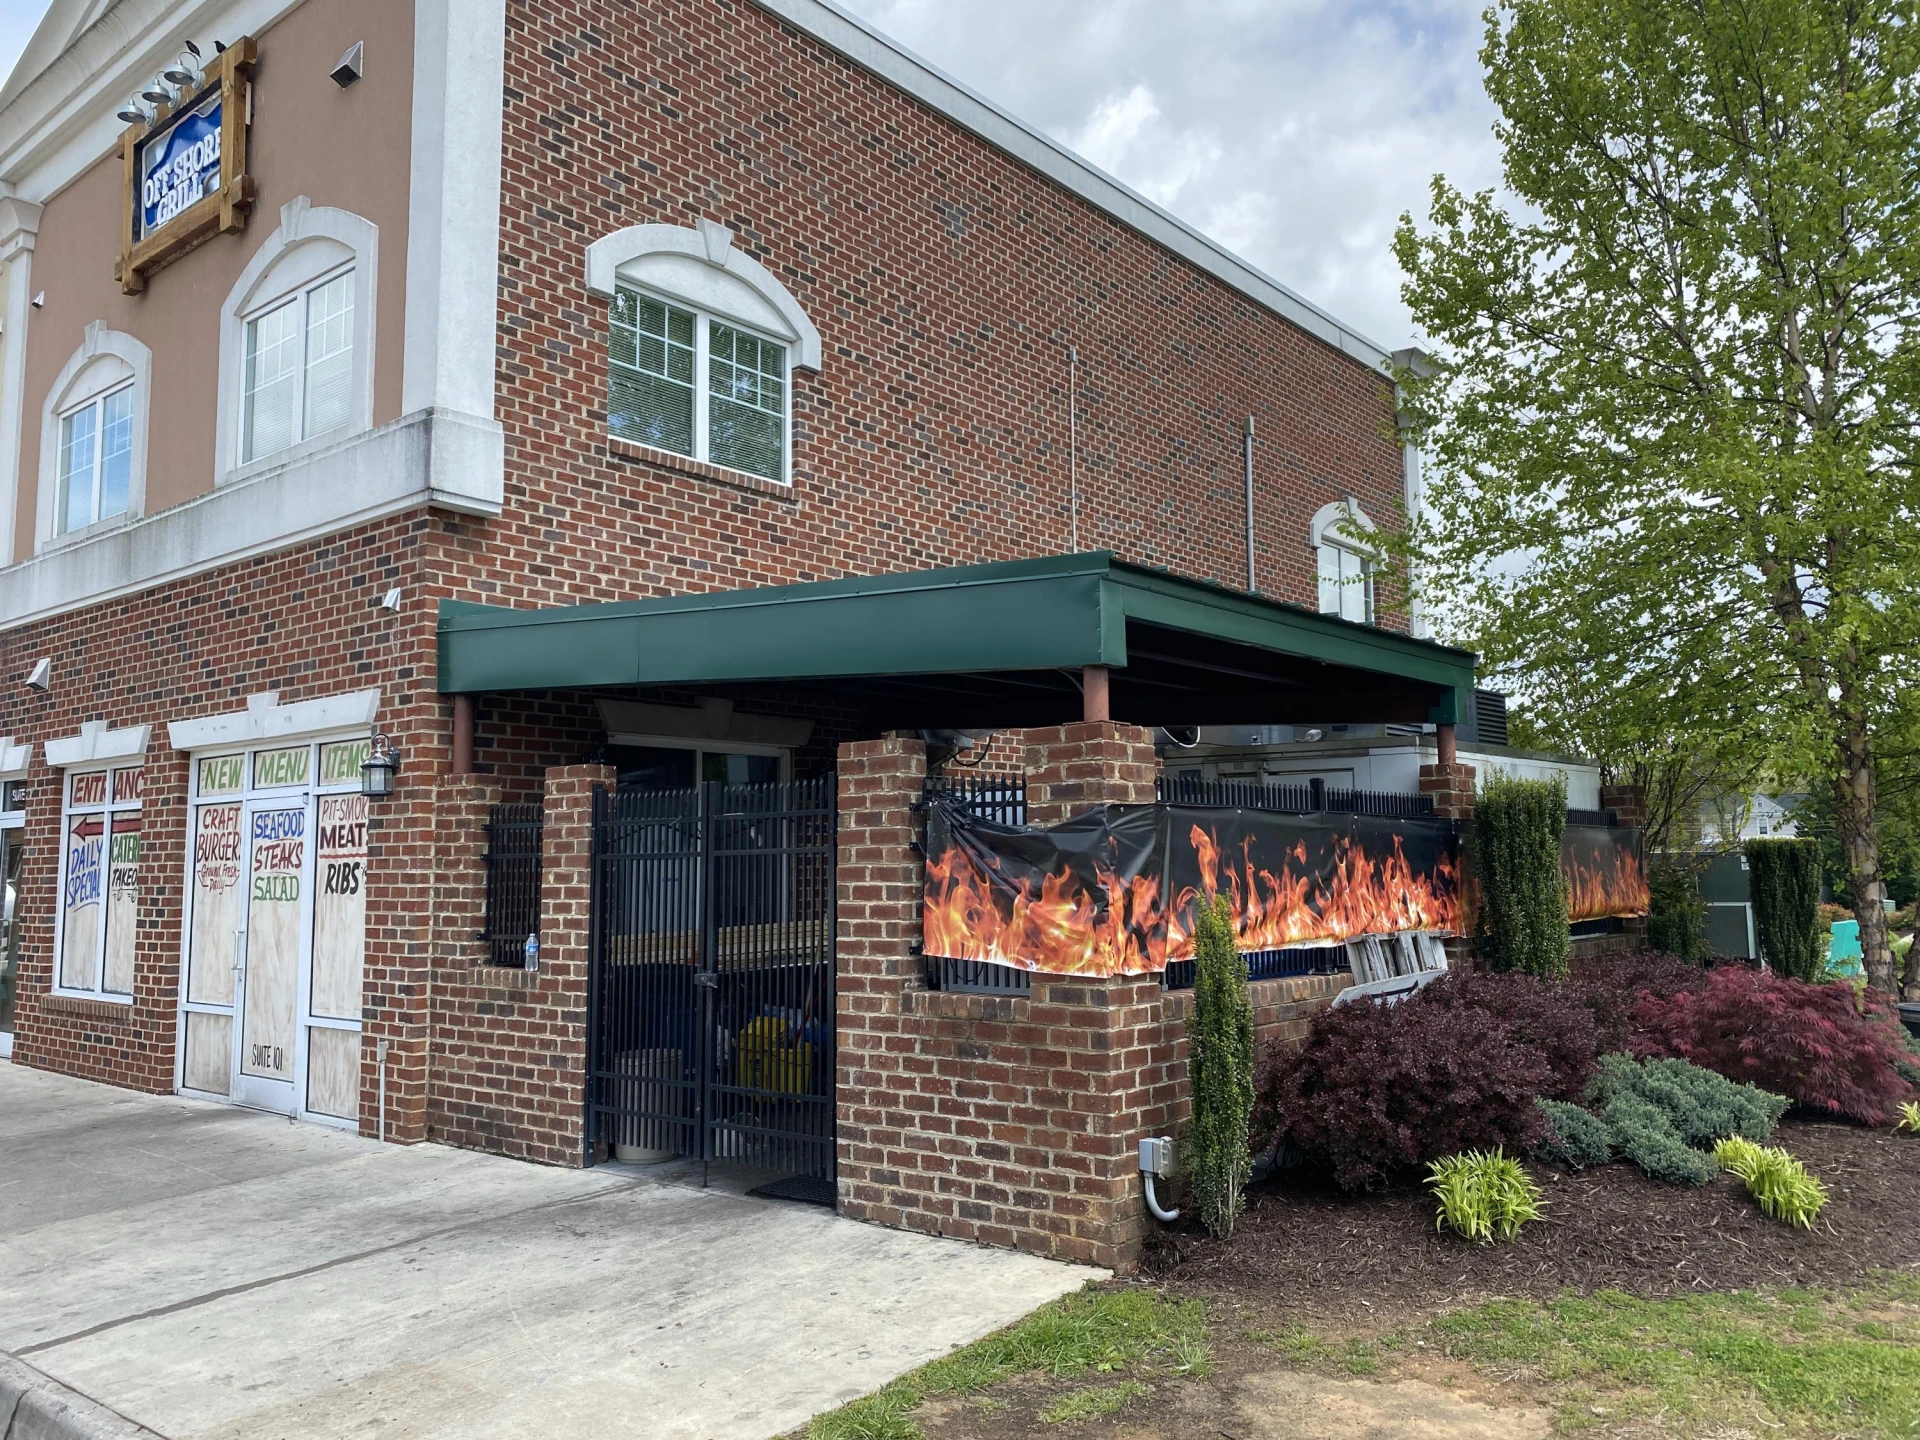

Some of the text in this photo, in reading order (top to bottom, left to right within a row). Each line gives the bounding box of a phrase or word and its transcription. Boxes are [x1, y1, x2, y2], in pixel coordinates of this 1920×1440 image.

[144, 125, 221, 208] OFF SHORE
[157, 173, 203, 225] GRILL
[204, 742, 371, 790] NEW MENU ITEMS
[203, 807, 241, 830] CRAFT
[254, 811, 304, 840] SEAFOOD
[197, 831, 241, 863] BURGER
[320, 823, 367, 850] MEAT
[71, 839, 103, 876] DAILY
[254, 842, 304, 872] STEAKS
[209, 878, 225, 895] Daily
[253, 876, 299, 902] SALAD
[325, 862, 360, 896] RIBS
[252, 1043, 283, 1071] SUITE 101
